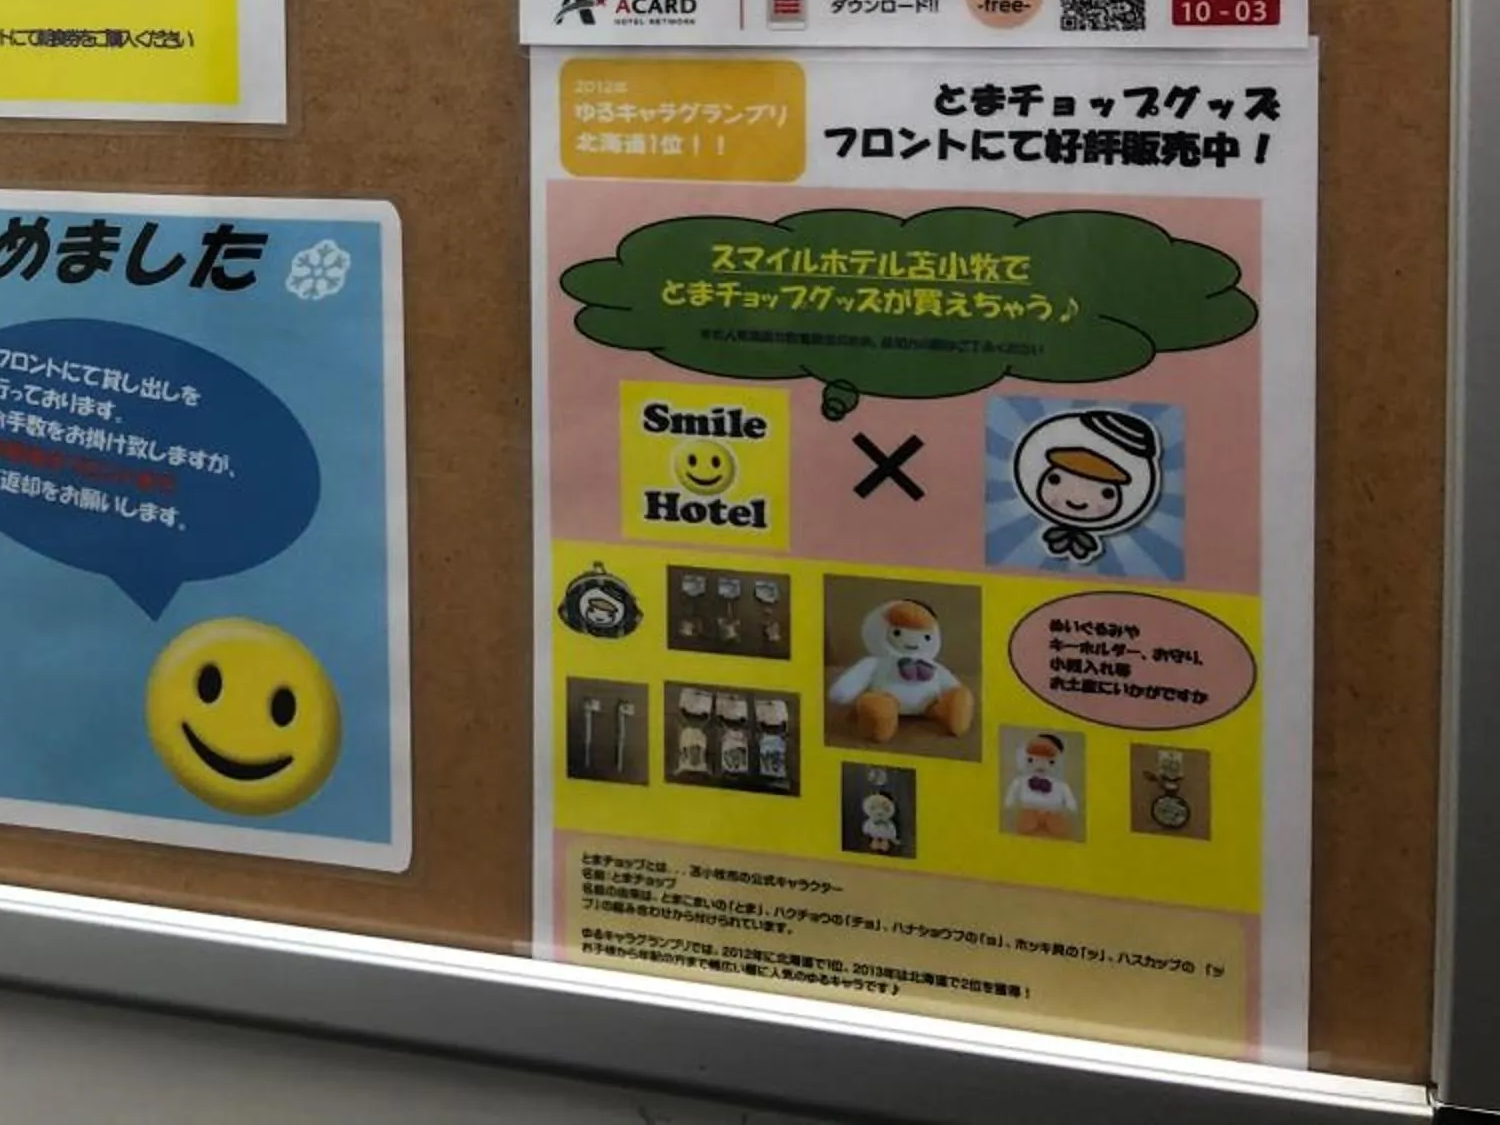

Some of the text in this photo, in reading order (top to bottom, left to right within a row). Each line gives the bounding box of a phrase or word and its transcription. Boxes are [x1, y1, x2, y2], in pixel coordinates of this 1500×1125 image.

[575, 100, 790, 130] ゆるキャラグランプリ
[934, 83, 1281, 122] とまチョップグッズ
[824, 126, 1271, 170] フロントにて好評販売中！
[710, 244, 1032, 283] スマイルホテル苫小牧で
[642, 402, 768, 441] Smile
[643, 492, 769, 532] Hotel
